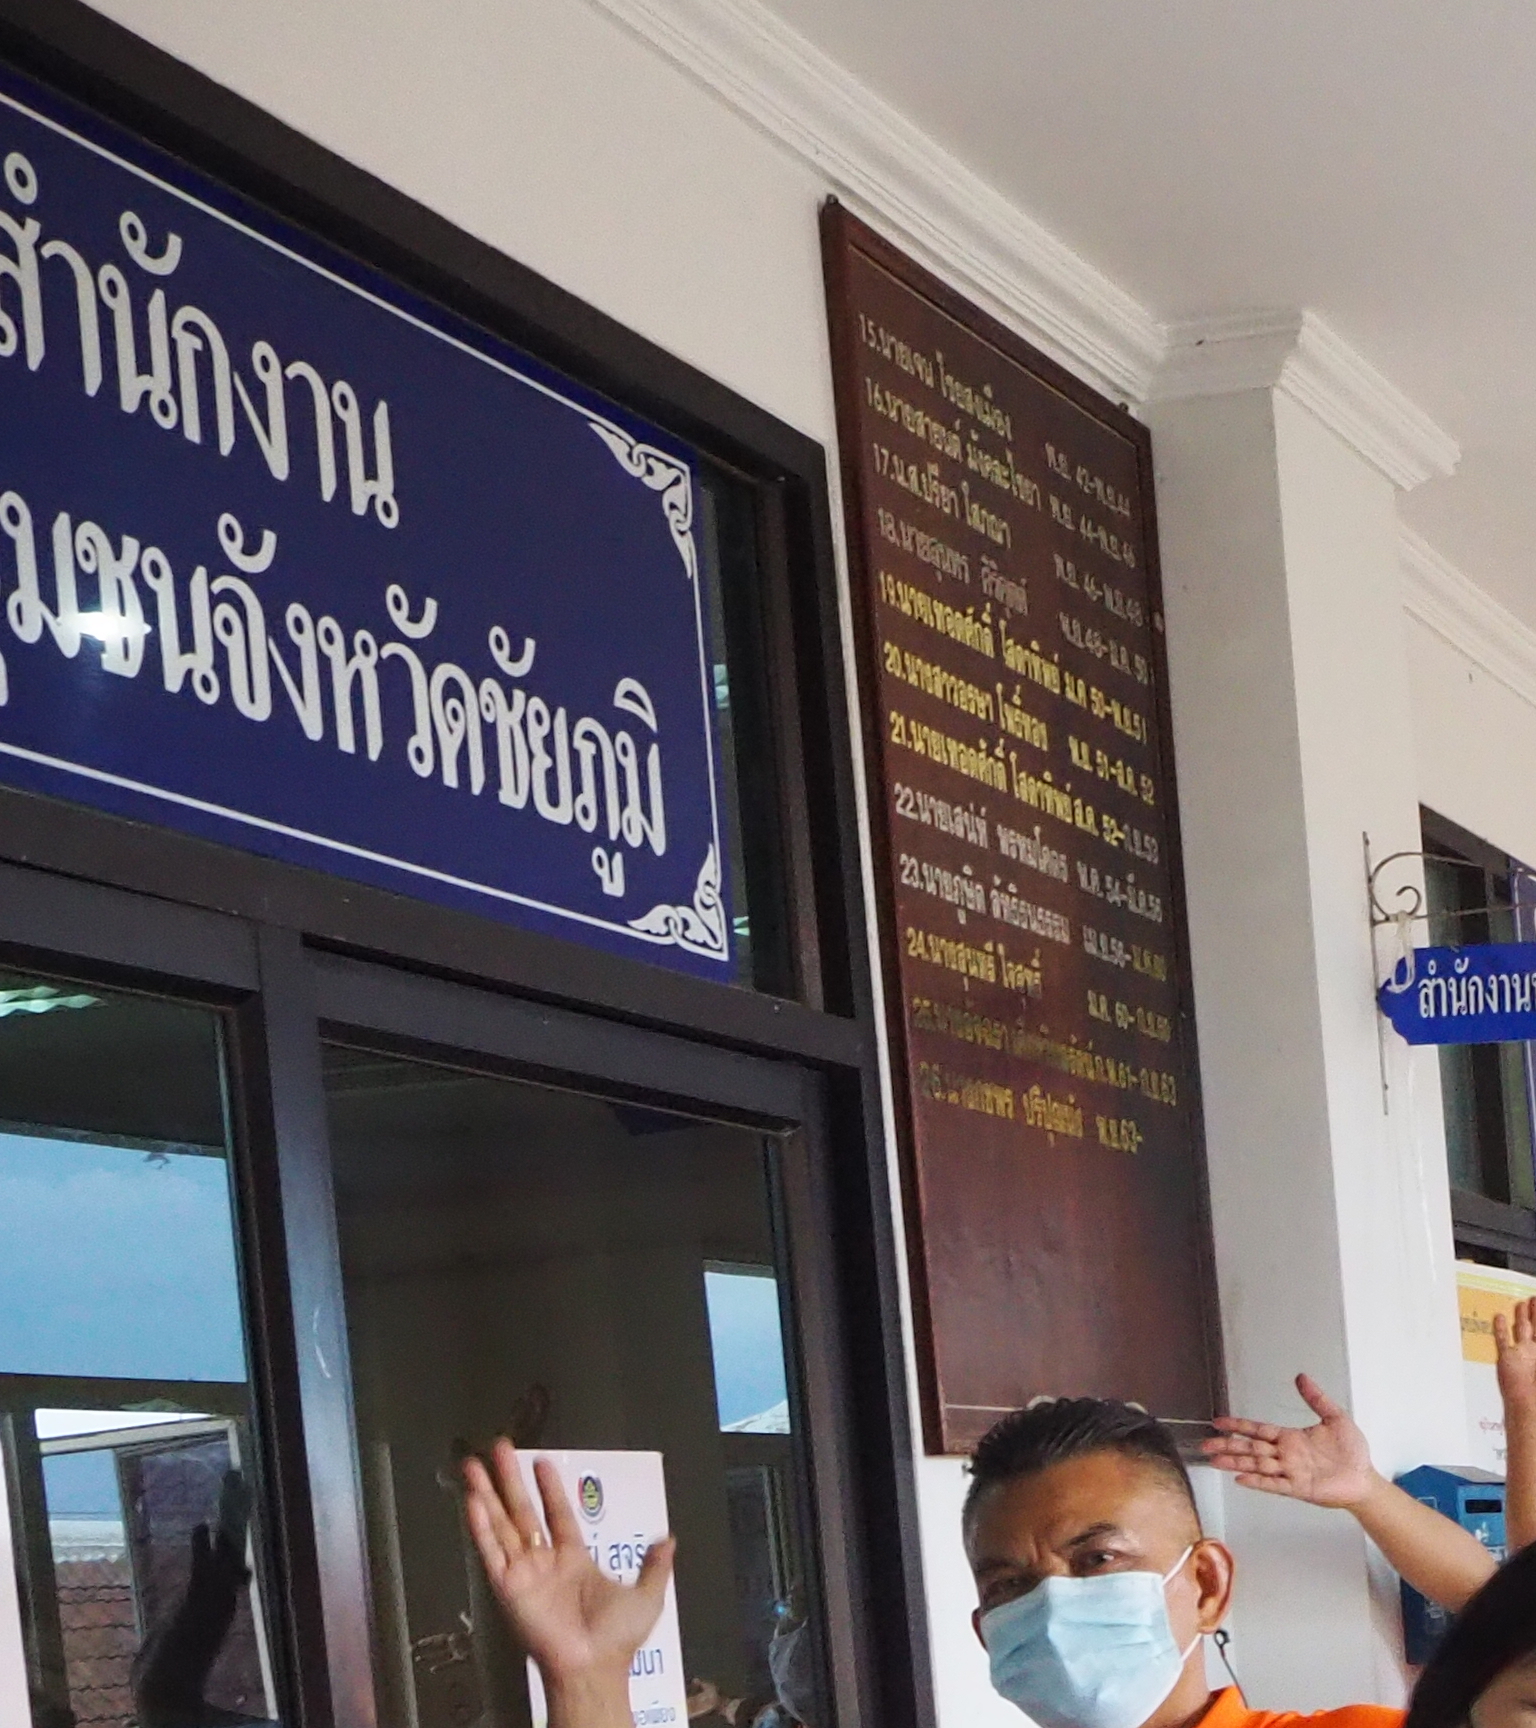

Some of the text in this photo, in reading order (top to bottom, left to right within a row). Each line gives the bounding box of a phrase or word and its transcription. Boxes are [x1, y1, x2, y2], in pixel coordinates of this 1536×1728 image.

[0, 152, 400, 530] สำนักงาน
[0, 490, 667, 897] มชนจังหวัดชัยภูมิ
